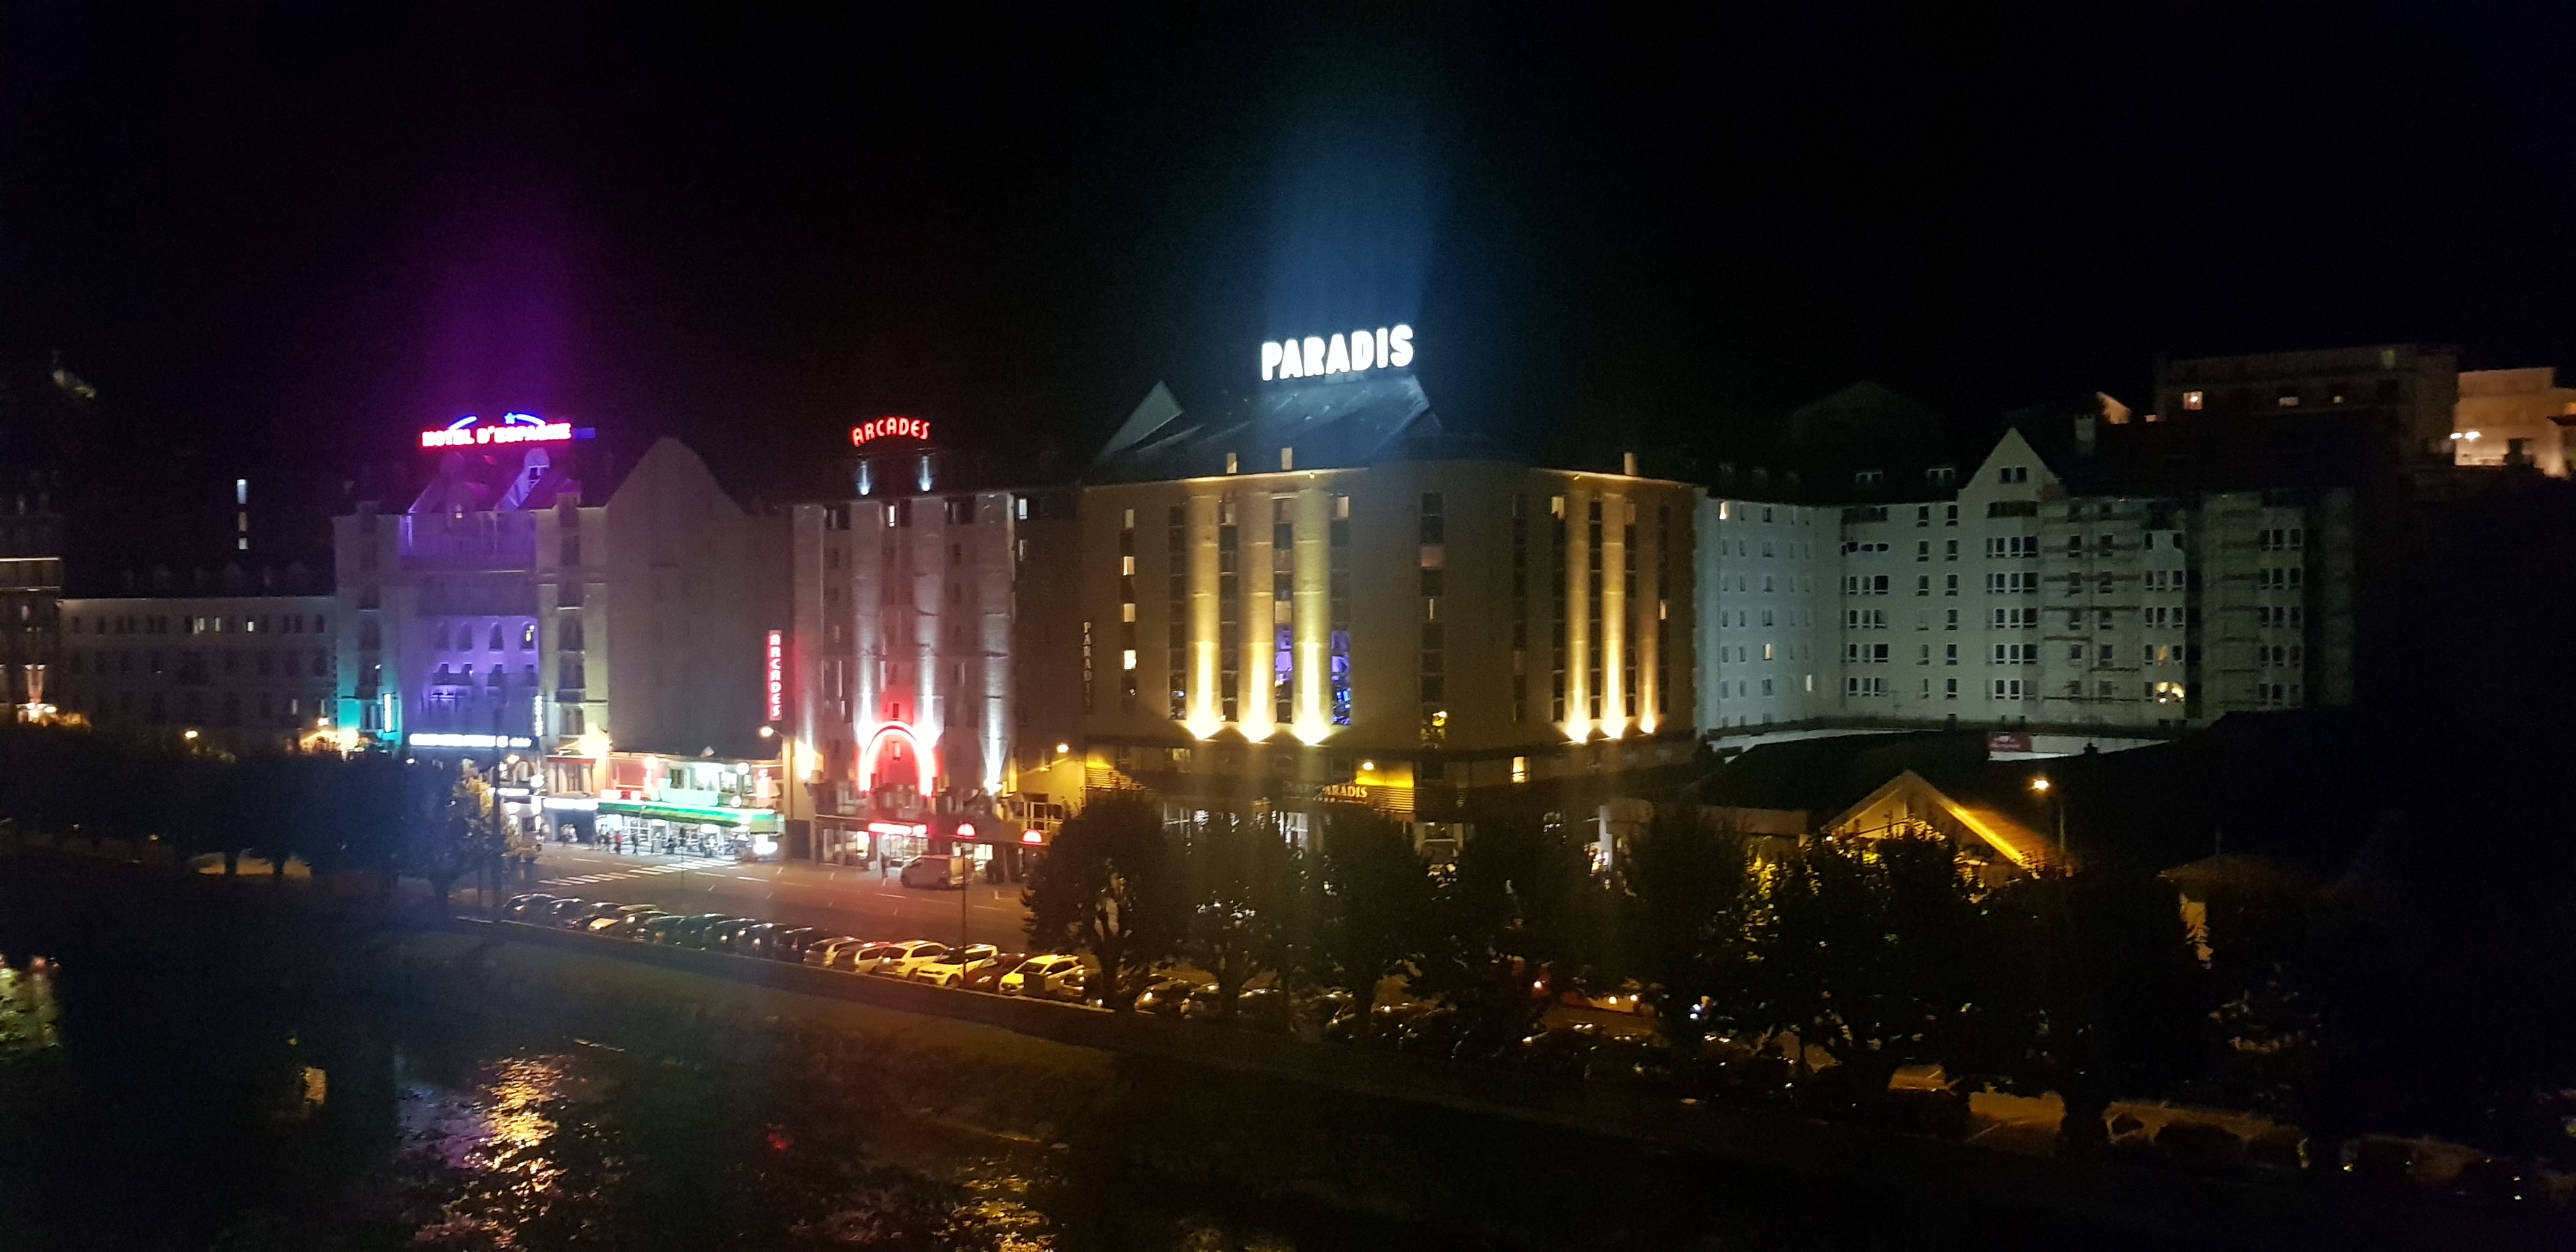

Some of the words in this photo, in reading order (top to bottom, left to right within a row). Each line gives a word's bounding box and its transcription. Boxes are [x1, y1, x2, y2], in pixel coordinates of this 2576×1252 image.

[1261, 324, 1414, 381] PARADIS
[852, 416, 930, 447] ARCADES
[770, 634, 781, 717] ARCADES
